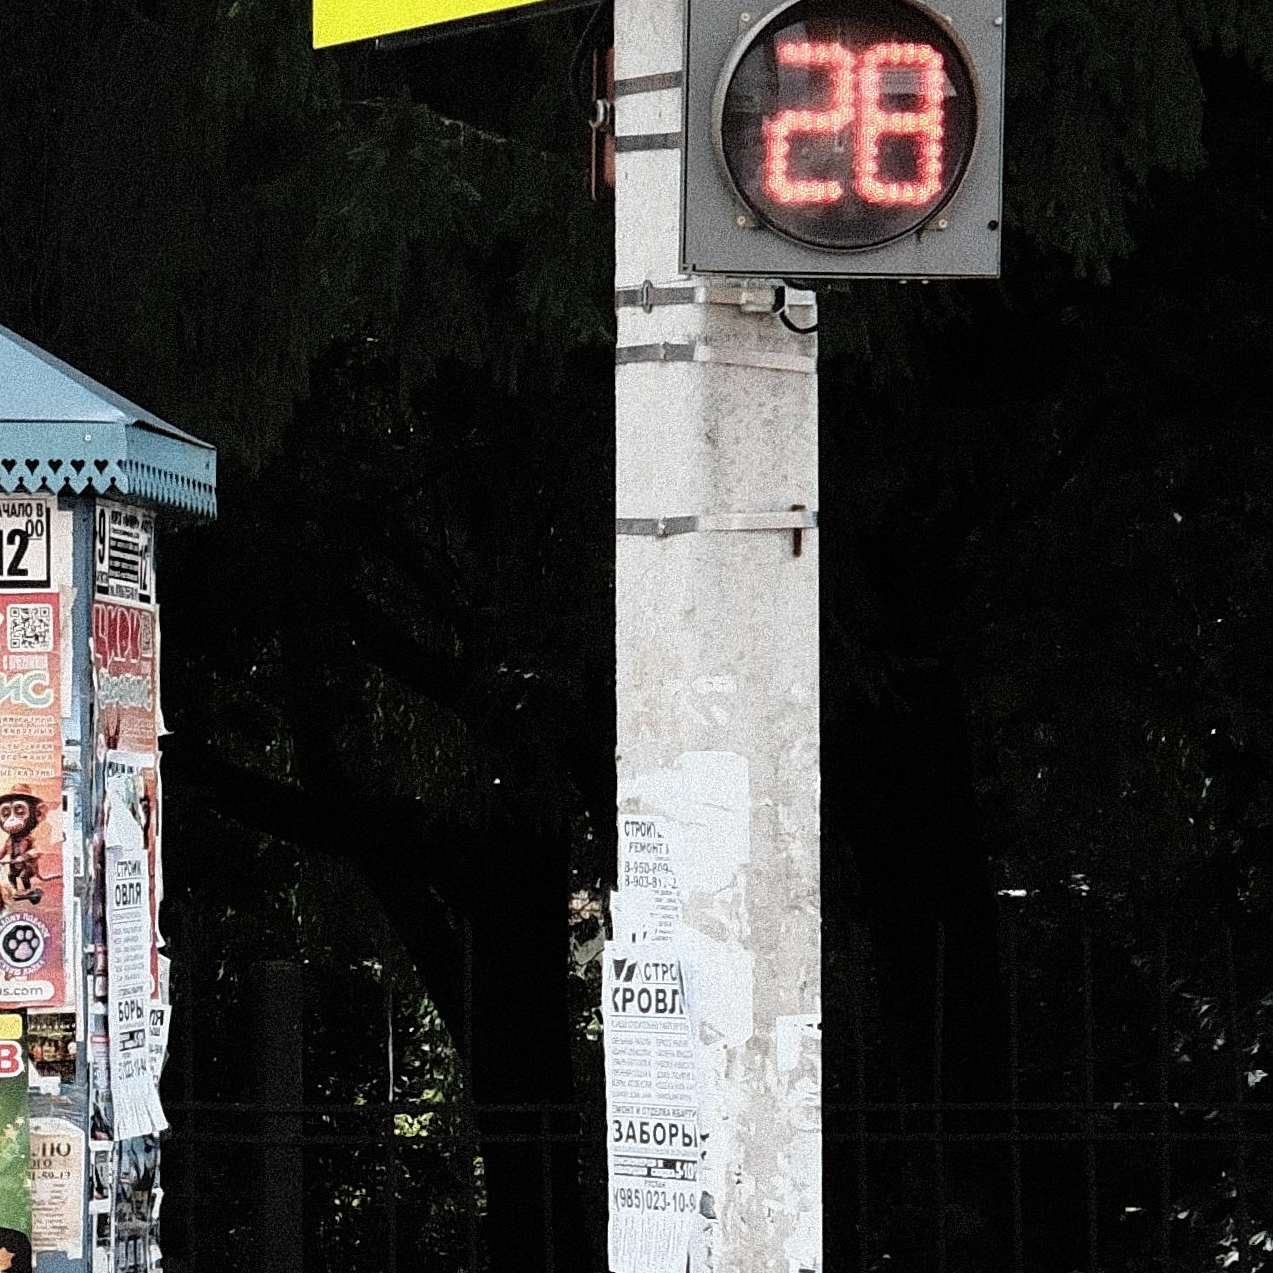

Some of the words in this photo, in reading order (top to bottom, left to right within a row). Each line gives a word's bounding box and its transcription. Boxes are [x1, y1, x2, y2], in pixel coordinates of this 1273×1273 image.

[762, 42, 944, 205] 28
[26, 519, 44, 537] 00
[115, 882, 142, 907] ОВЛЯ
[643, 962, 677, 982] СТРО
[119, 996, 144, 1023] БОРЫ
[611, 986, 684, 1015] КРОВЛ
[613, 1119, 698, 1148] ЗАБОРЫ
[613, 1187, 645, 1214] (985)
[646, 1189, 696, 1213] 023-10-9
